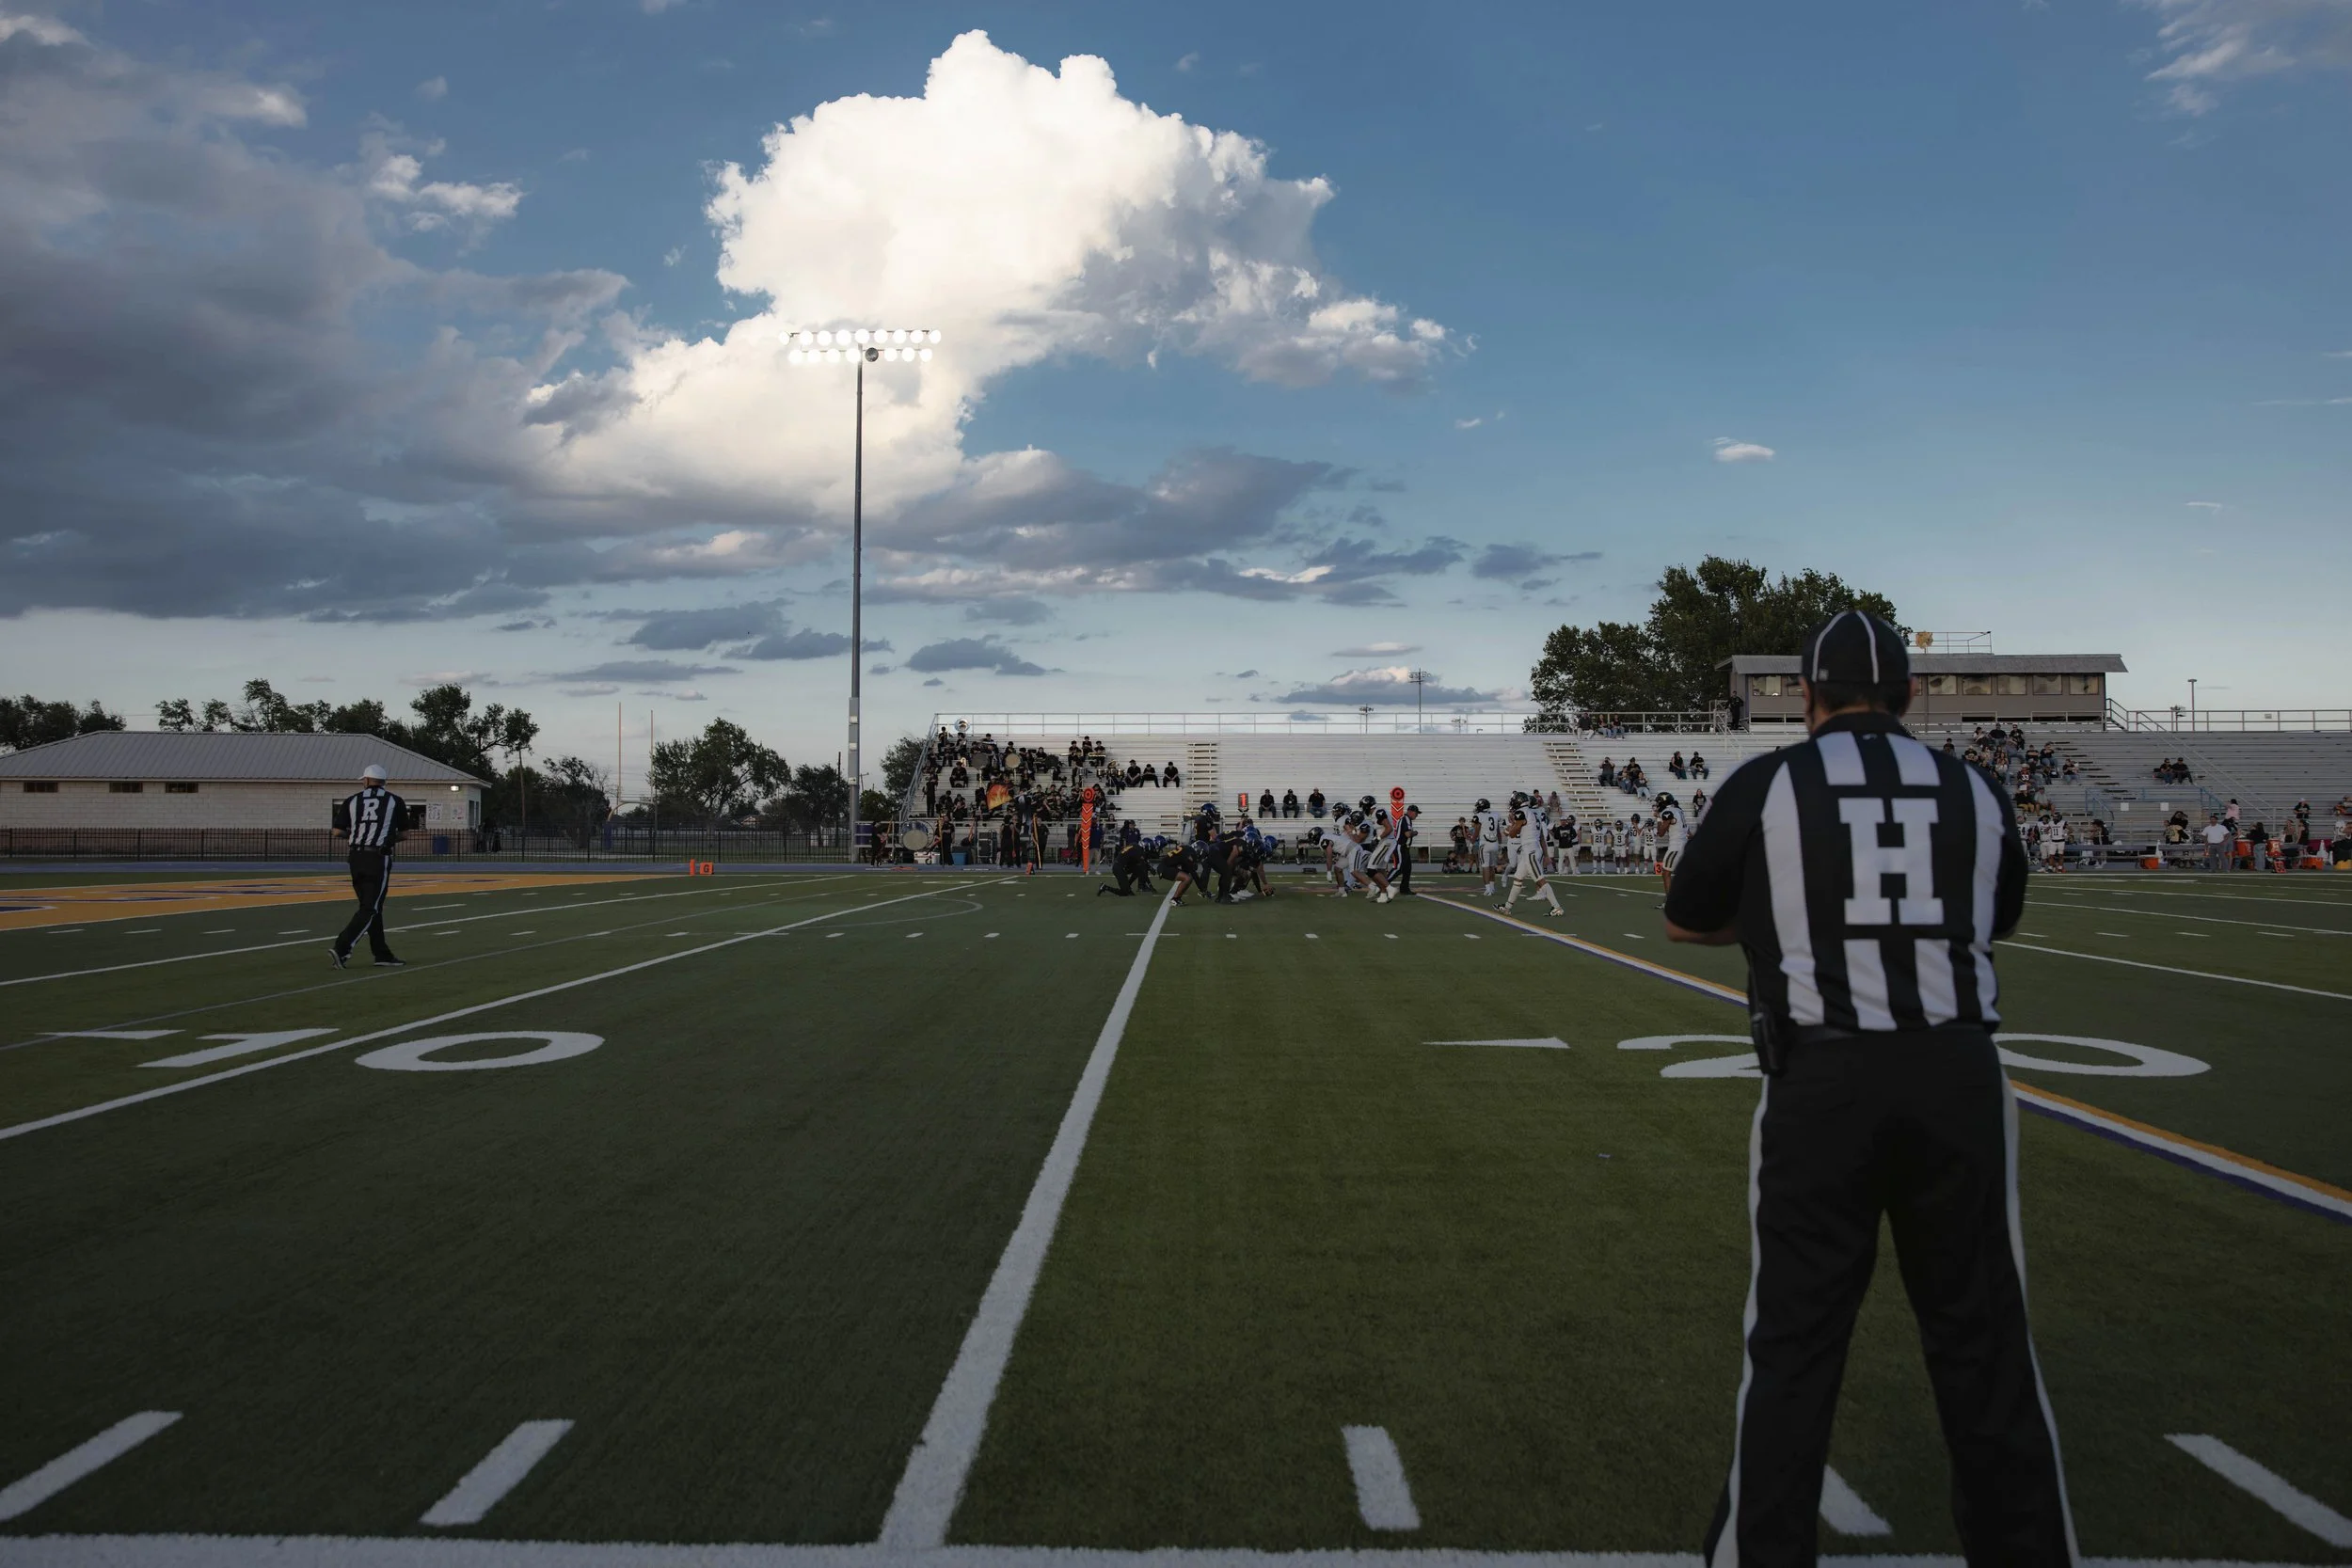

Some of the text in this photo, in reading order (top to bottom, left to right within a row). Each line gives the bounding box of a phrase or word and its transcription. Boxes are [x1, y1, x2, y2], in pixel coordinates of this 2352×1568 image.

[361, 798, 380, 821] R
[1488, 816, 1495, 831] 3
[1837, 798, 1944, 926] H
[135, 1027, 606, 1071] 10
